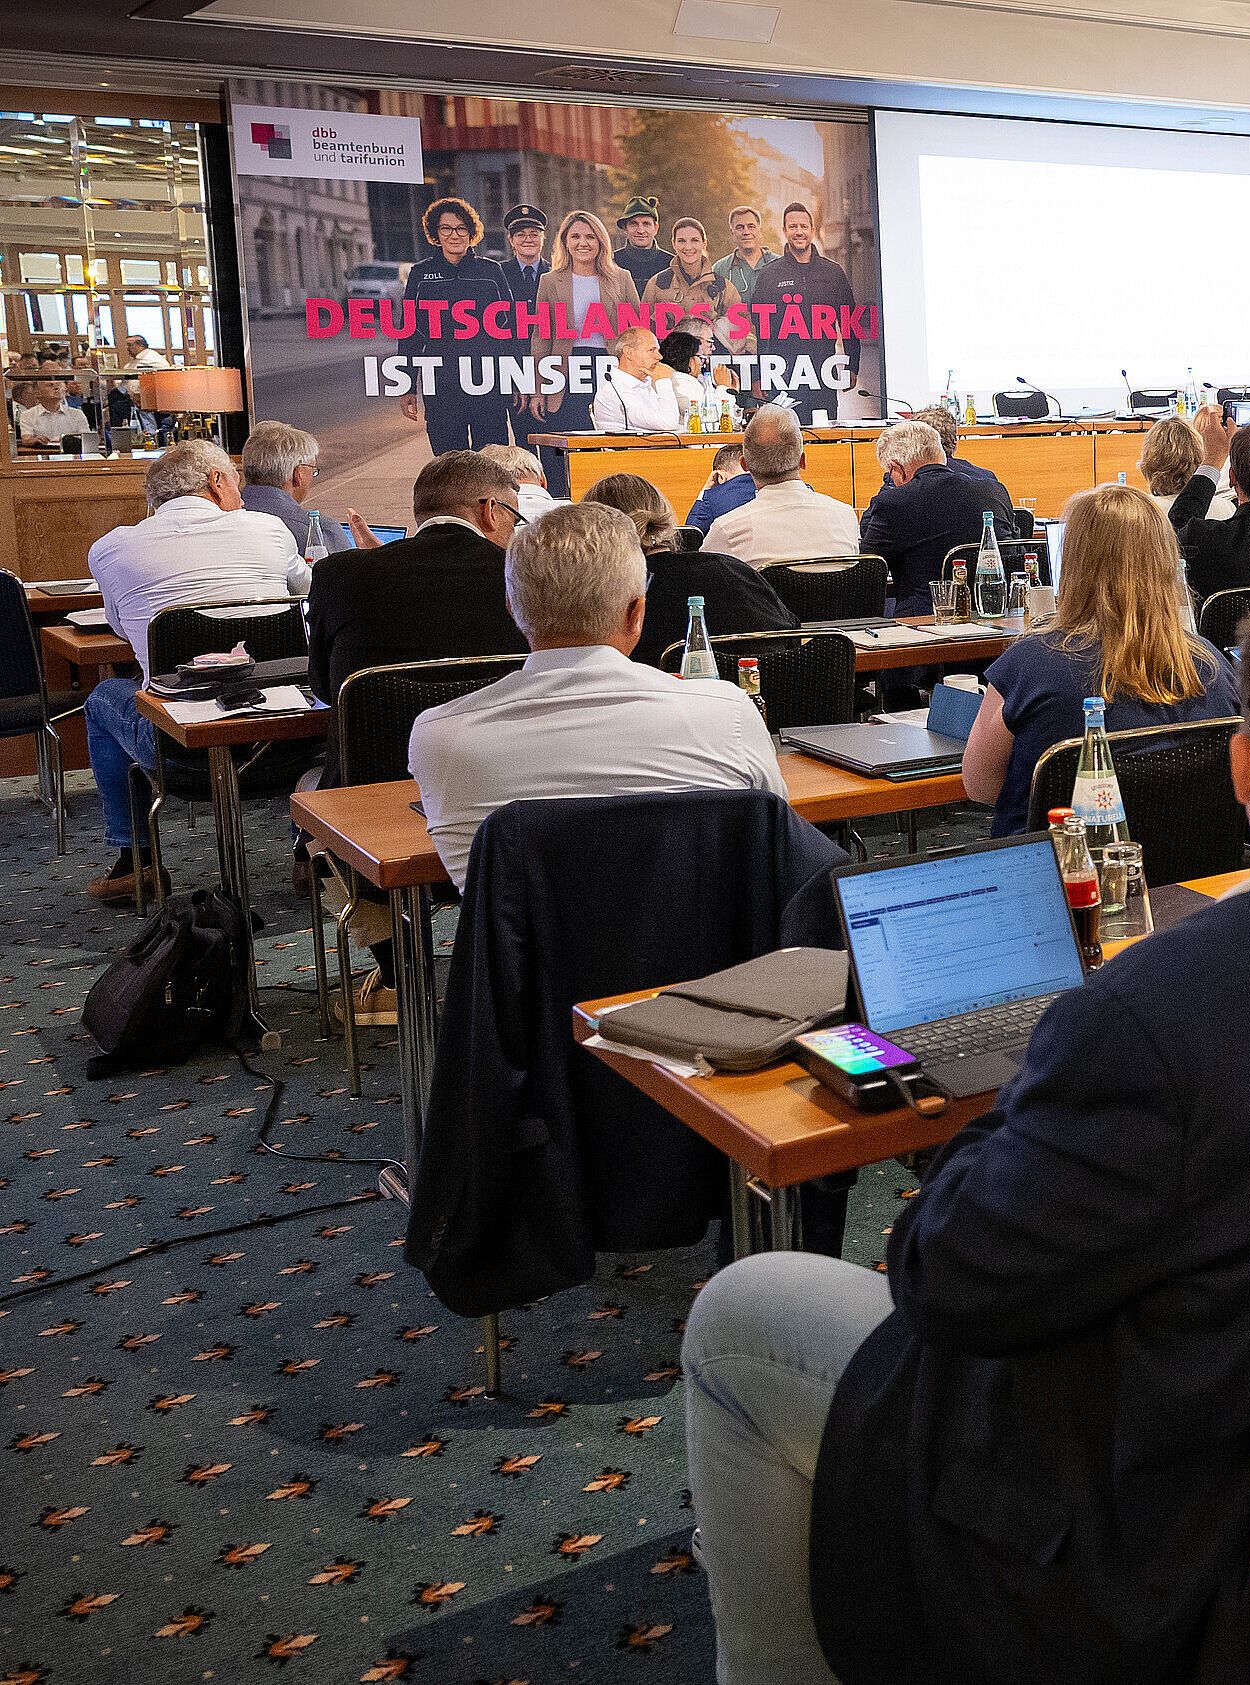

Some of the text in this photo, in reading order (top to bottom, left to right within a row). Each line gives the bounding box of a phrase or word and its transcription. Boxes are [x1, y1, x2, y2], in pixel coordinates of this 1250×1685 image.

[311, 127, 337, 139] dbb
[312, 138, 405, 156] beamtenbund
[313, 151, 406, 167] und tarifunion
[423, 272, 444, 280] ZOLL
[363, 355, 444, 398] IST
